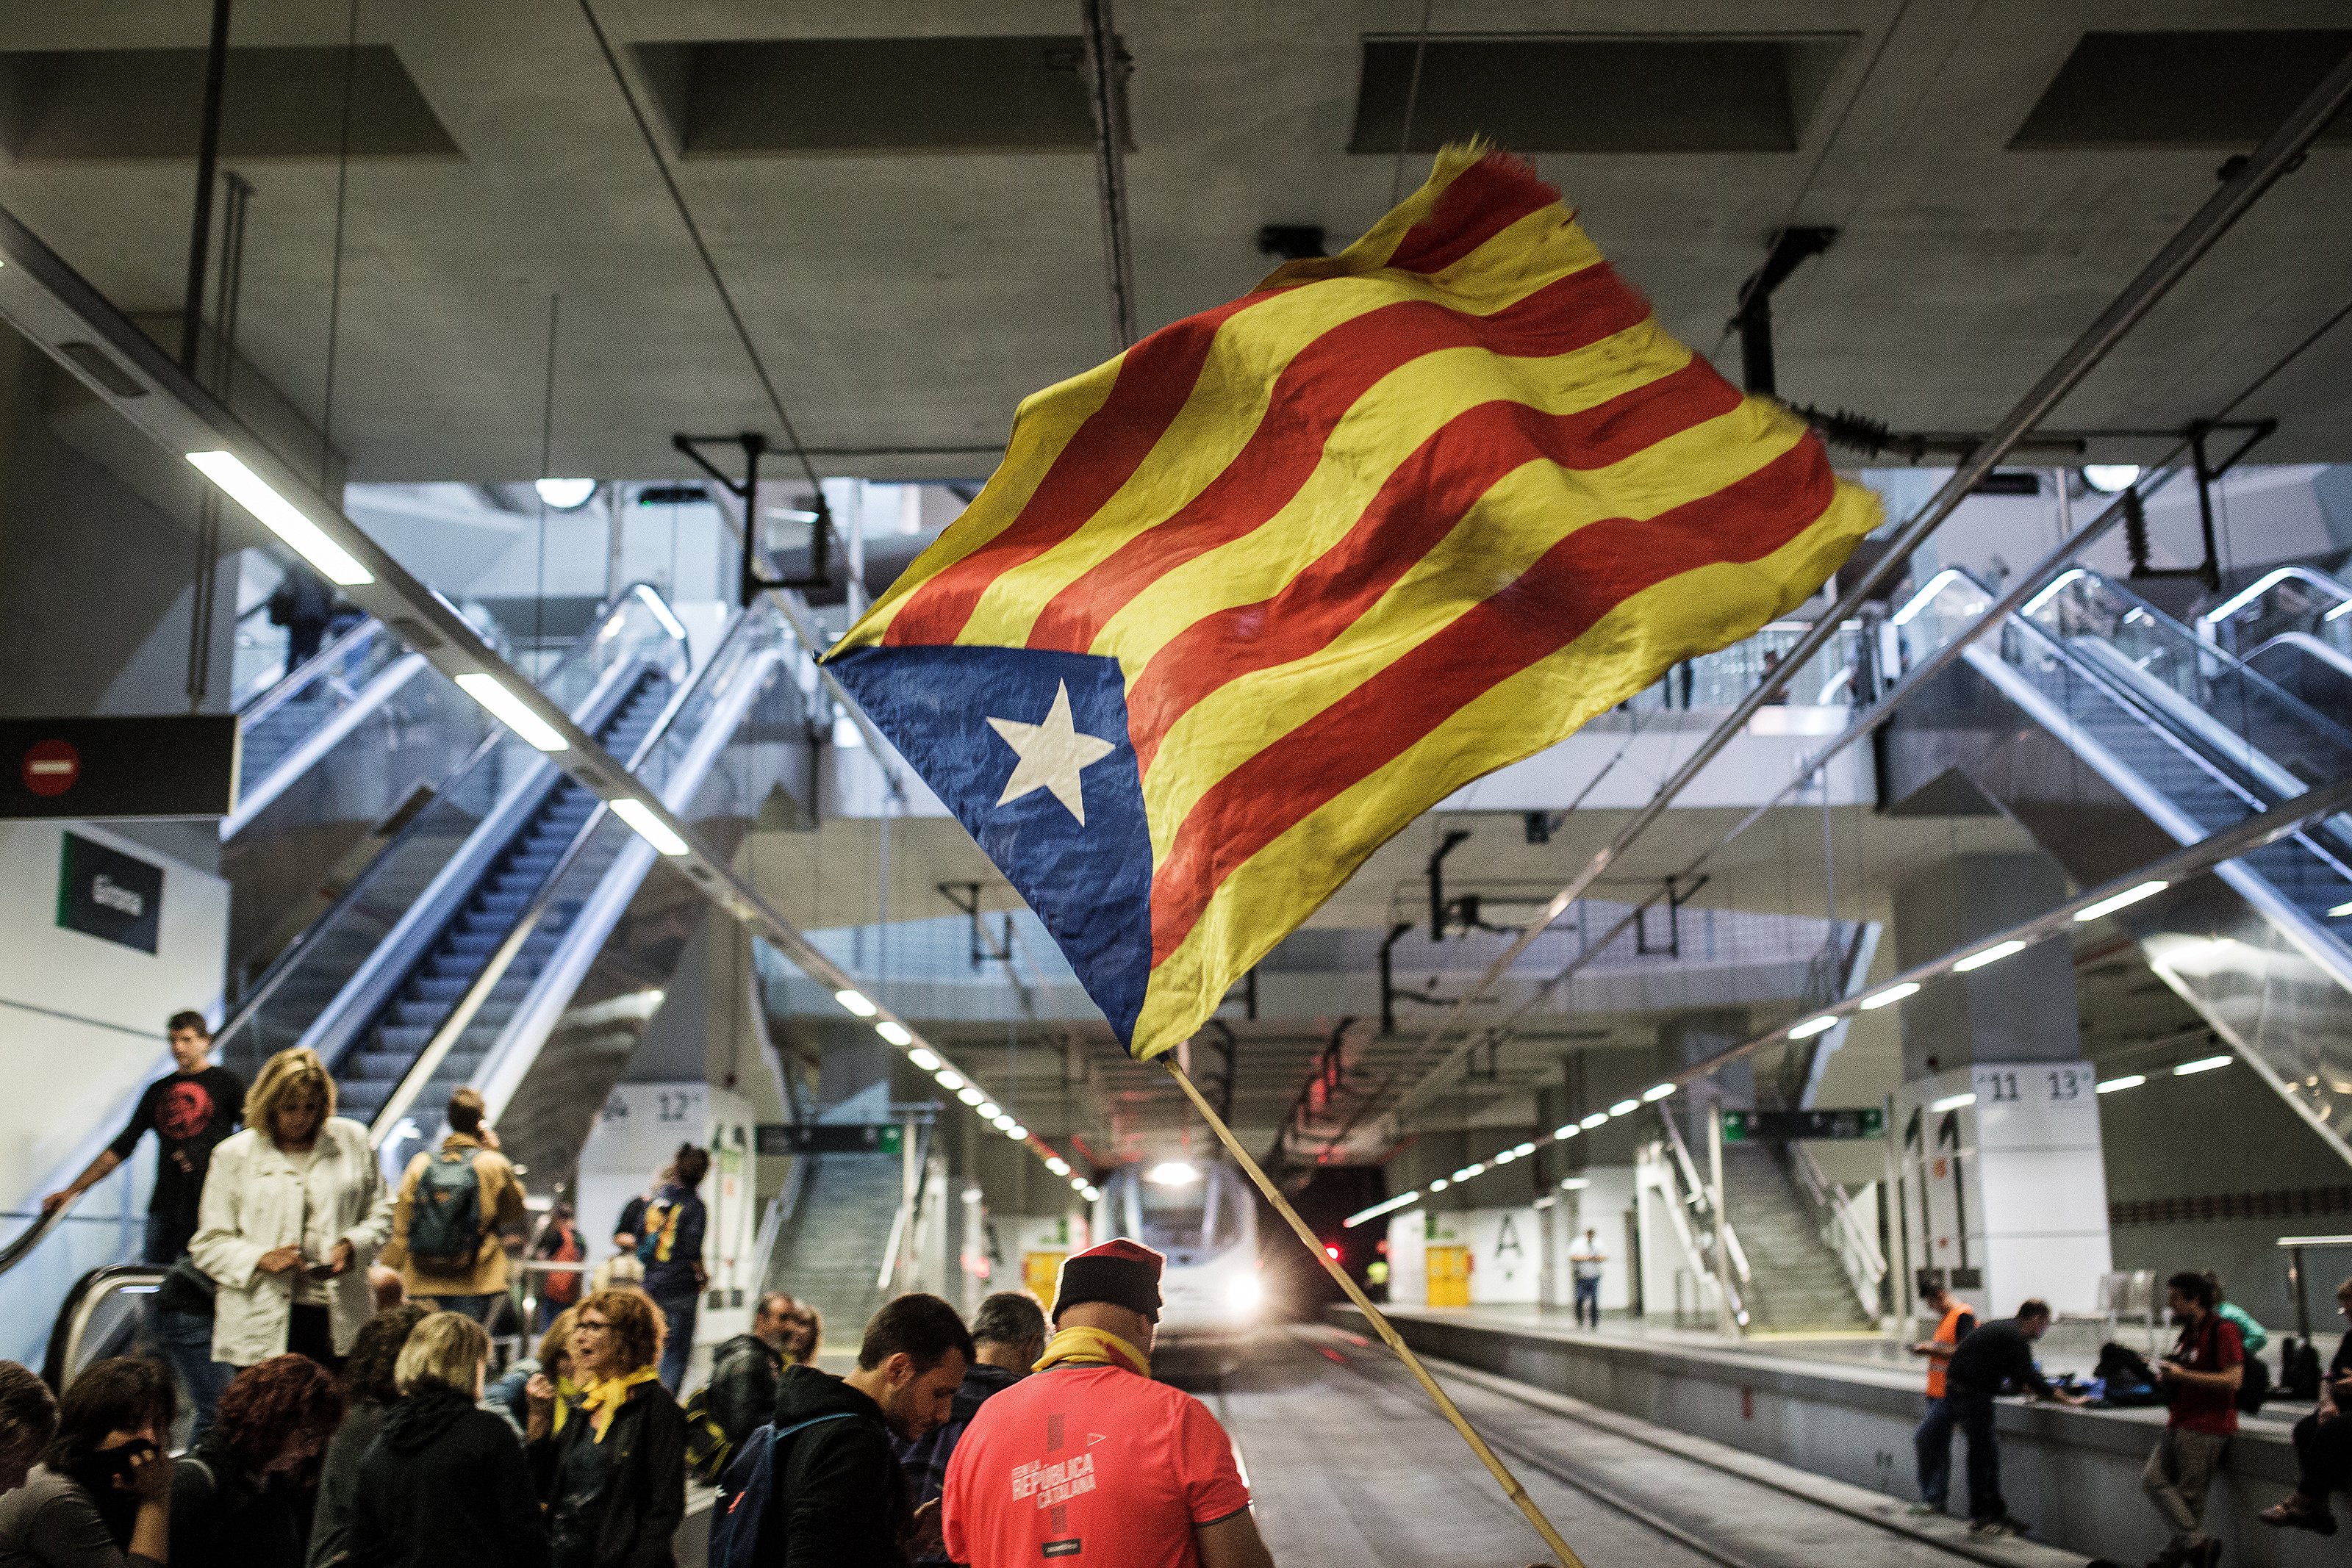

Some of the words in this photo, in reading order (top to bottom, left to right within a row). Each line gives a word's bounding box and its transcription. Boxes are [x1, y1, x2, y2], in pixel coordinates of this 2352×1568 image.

[1990, 1071, 2019, 1101] 11
[2048, 1070, 2079, 1100] 13
[1494, 1214, 1524, 1258] A
[1012, 1453, 1094, 1501] REPÚBLICA
